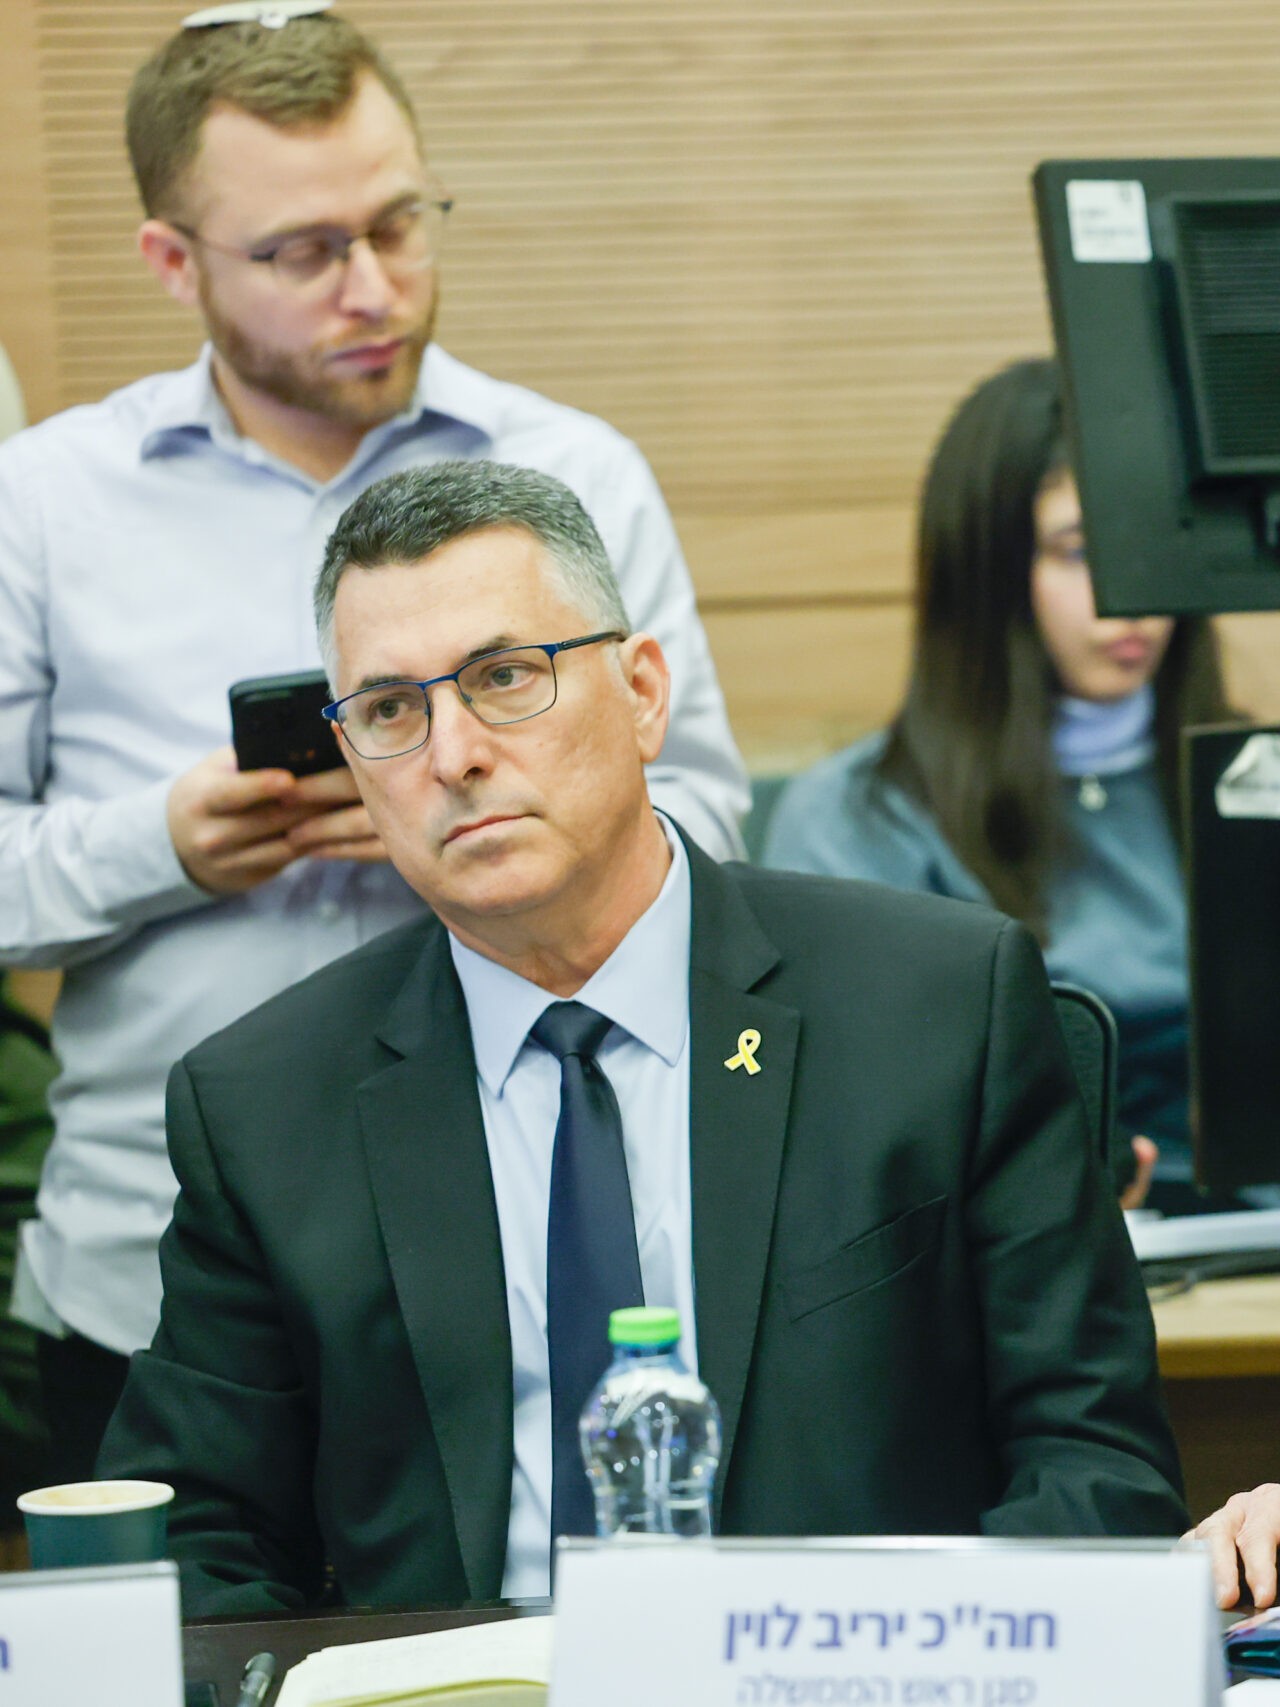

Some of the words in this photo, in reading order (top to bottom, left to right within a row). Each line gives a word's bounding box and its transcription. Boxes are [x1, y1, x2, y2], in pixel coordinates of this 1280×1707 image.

[725, 1602, 801, 1662] לוין
[814, 1612, 906, 1649] יריב
[737, 1671, 892, 1706] הממשלה
[901, 1675, 974, 1706] ראש
